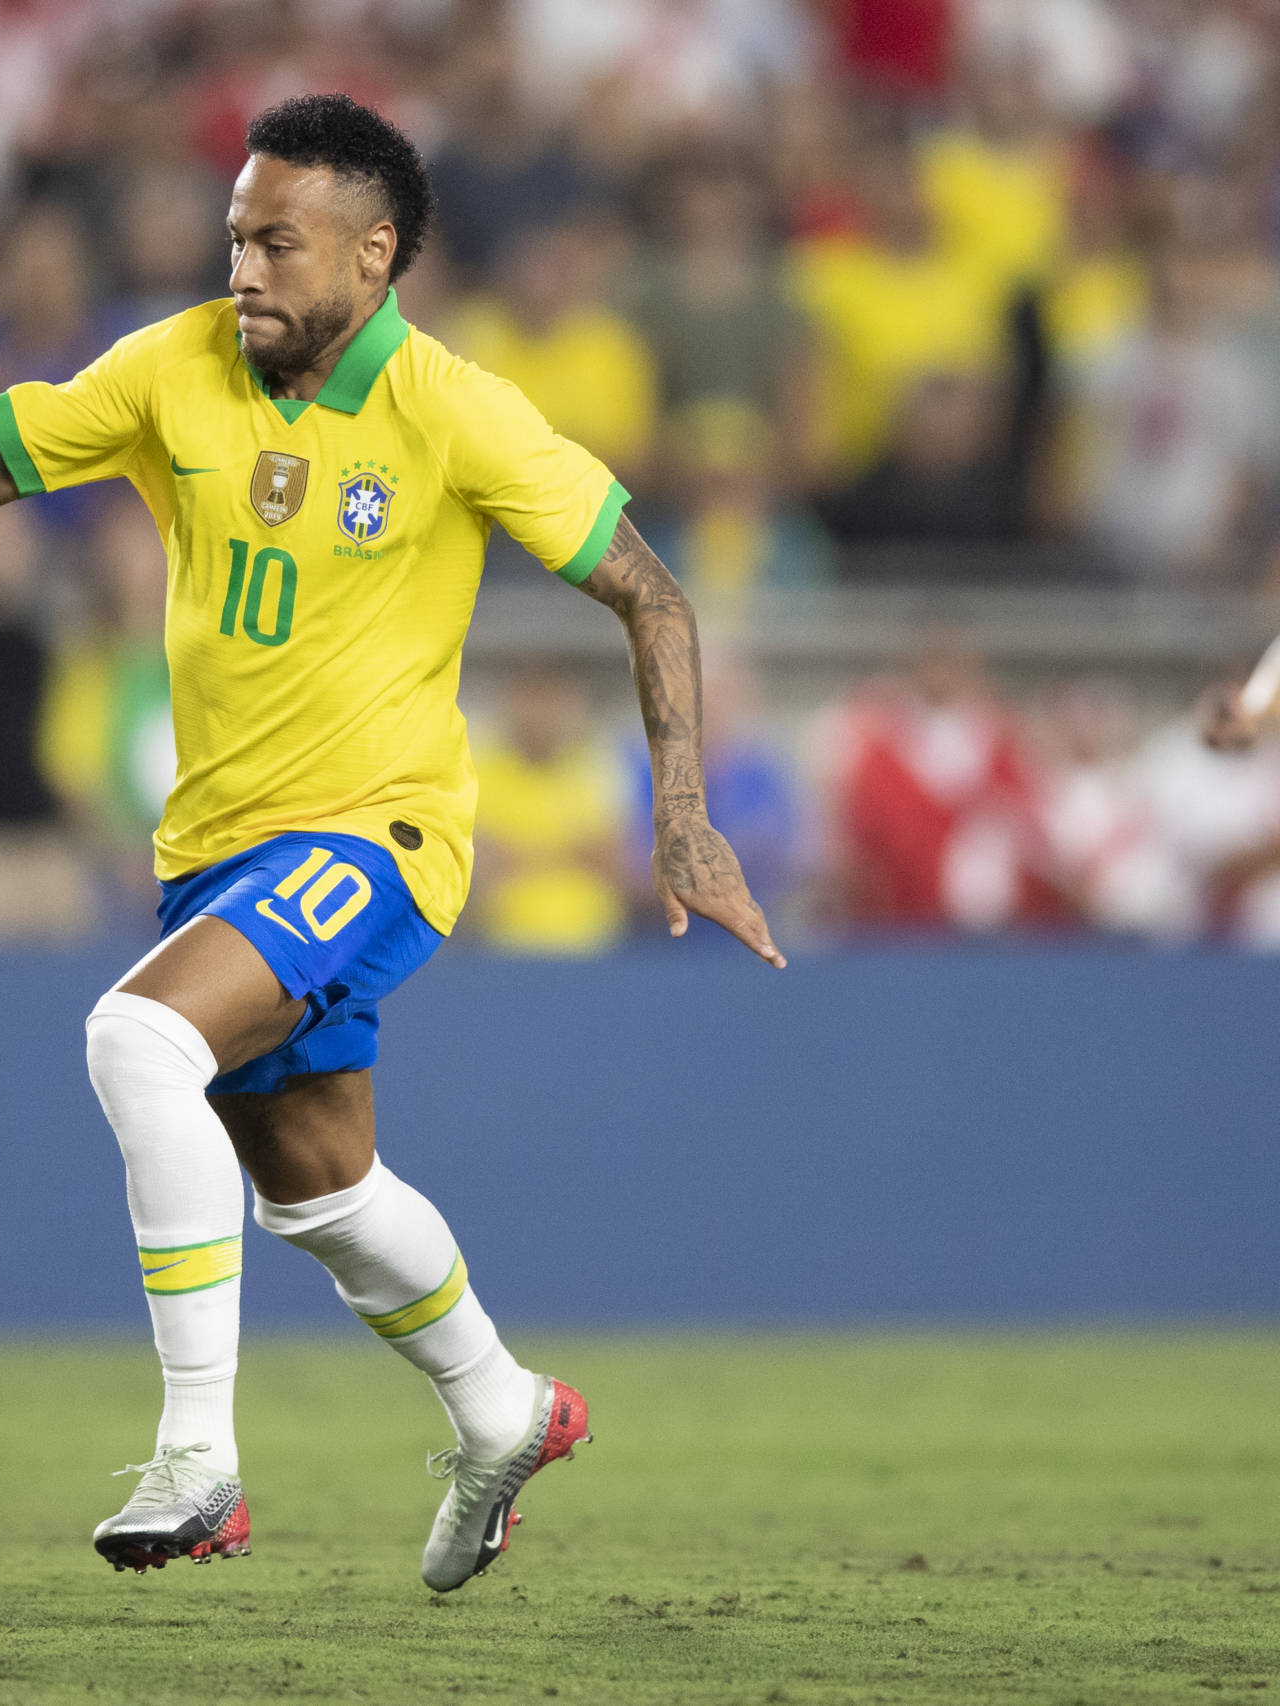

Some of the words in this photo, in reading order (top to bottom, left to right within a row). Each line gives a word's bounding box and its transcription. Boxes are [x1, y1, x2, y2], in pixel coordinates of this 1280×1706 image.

[355, 501, 374, 511] CBF
[219, 537, 298, 647] 10
[272, 847, 372, 942] 10
